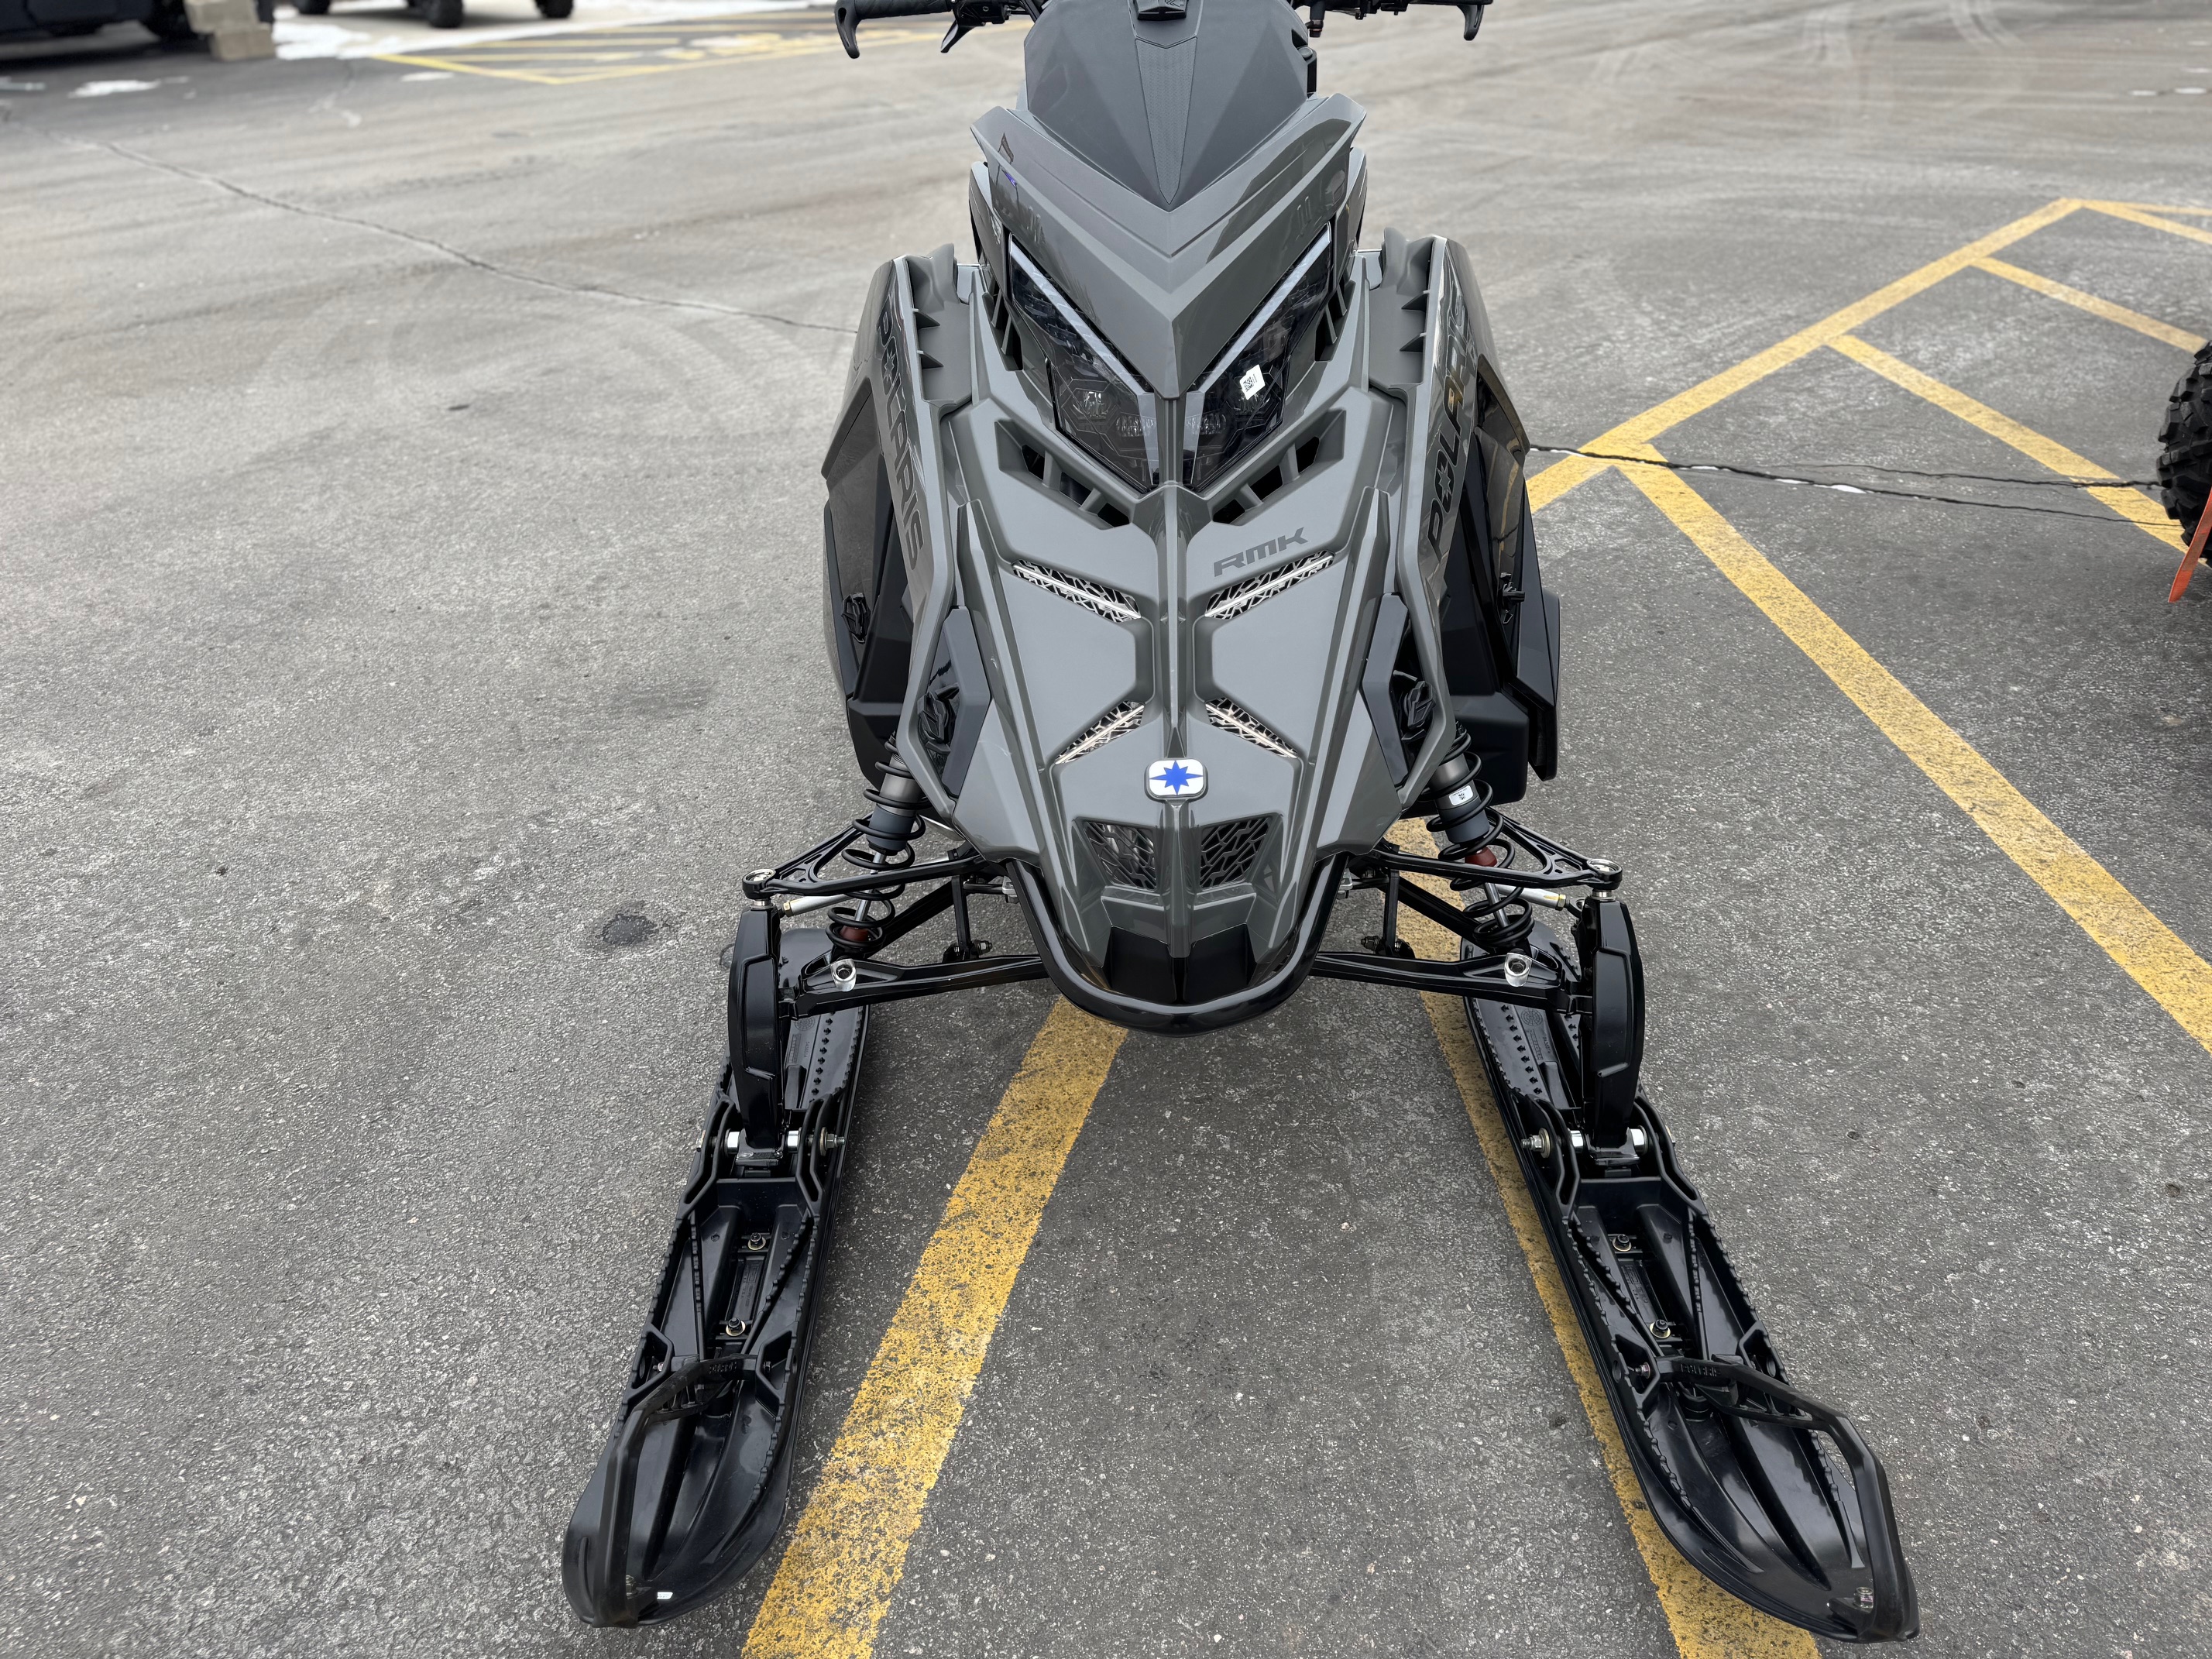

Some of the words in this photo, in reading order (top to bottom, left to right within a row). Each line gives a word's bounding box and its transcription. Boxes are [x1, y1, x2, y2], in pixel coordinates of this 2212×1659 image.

[876, 294, 924, 570] POLARIS
[1214, 527, 1308, 577] RMK
[1426, 280, 1468, 563] POLARIS
